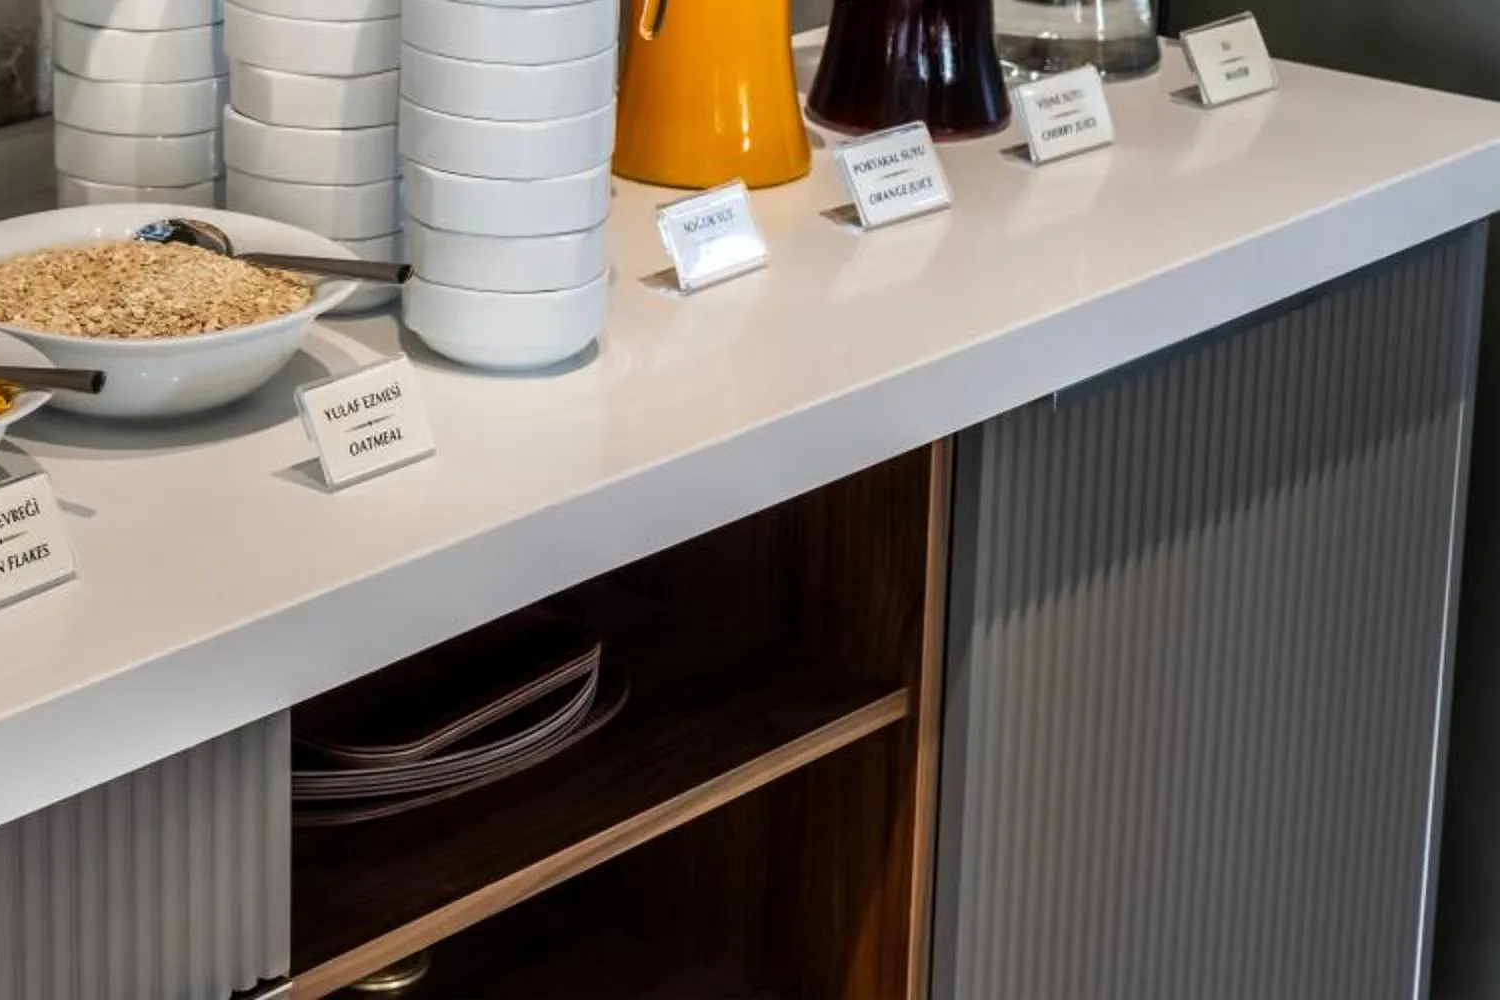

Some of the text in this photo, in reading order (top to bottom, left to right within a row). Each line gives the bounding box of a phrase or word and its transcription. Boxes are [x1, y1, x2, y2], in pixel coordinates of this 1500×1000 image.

[1041, 123, 1074, 141] CHERRY
[853, 153, 899, 175] PORTAKAL
[869, 176, 933, 205] ORANGE JUICE
[323, 381, 403, 422] YULAF EZMESİ
[349, 428, 404, 456] OATMEAL
[7, 543, 51, 573] FLAKES
